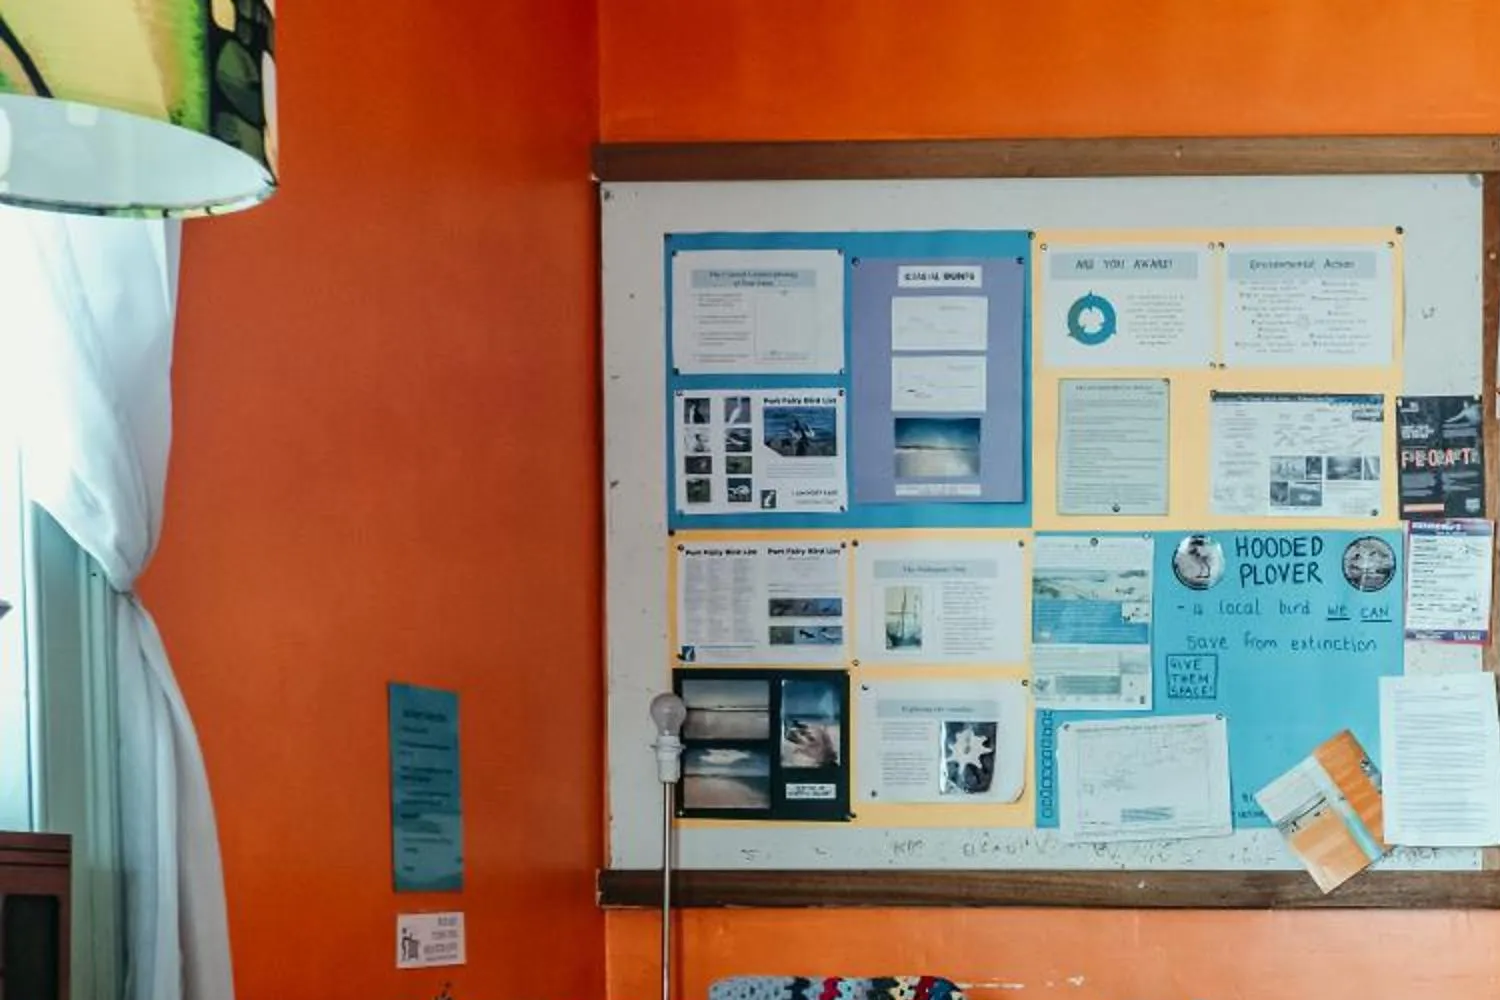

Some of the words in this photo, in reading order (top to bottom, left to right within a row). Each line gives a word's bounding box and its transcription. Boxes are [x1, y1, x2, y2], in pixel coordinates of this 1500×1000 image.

[1235, 535, 1324, 559] HOODED
[1239, 561, 1323, 588] PLOVER
[1218, 597, 1261, 616] local
[1279, 599, 1311, 616] bird
[1326, 604, 1350, 617] WE
[1360, 605, 1389, 619] CAN
[1244, 630, 1278, 649] from
[1290, 635, 1378, 653] extinction
